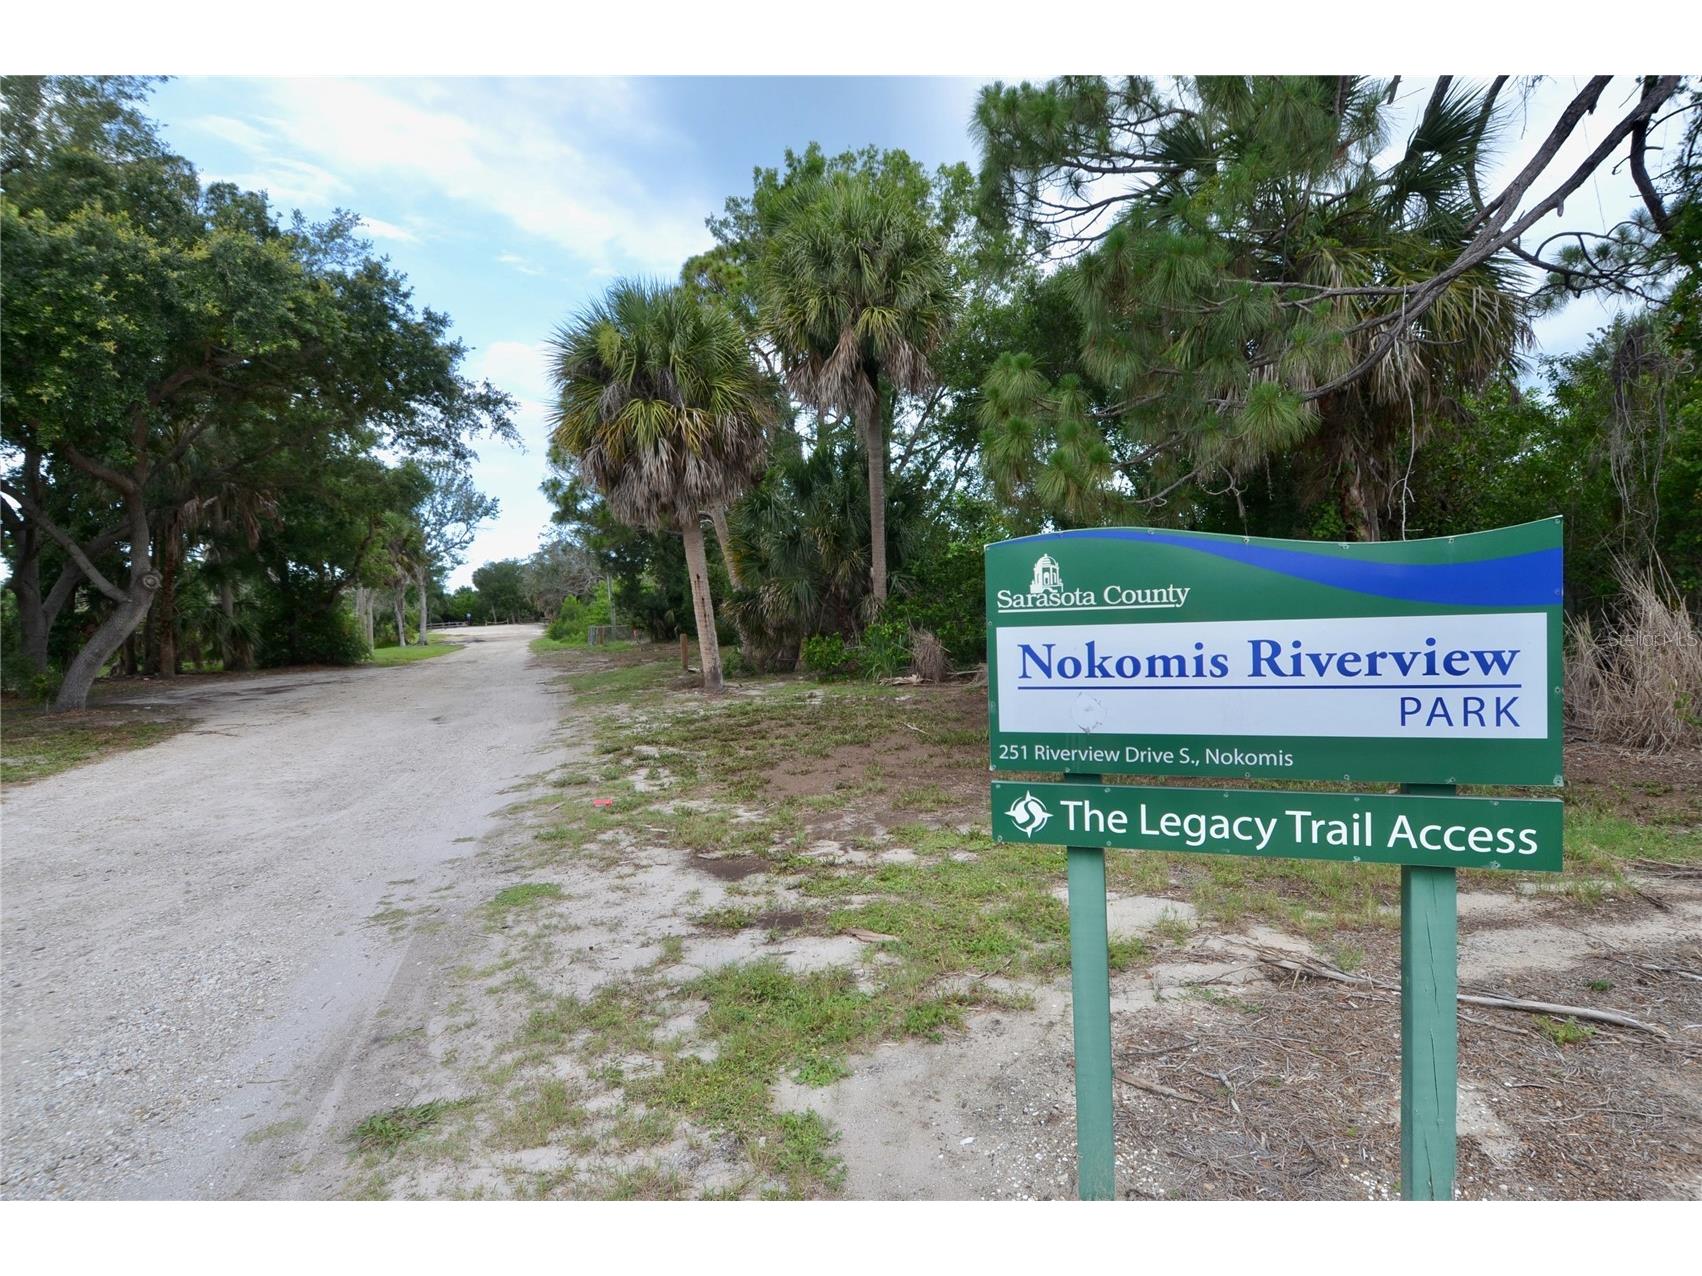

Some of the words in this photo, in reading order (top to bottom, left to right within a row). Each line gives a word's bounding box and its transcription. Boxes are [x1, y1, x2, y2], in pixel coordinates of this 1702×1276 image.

[997, 589, 1097, 609] Sarasota
[1102, 584, 1190, 608] County
[1018, 640, 1229, 680] Nokomis
[1248, 638, 1520, 678] Riverview
[1400, 696, 1520, 728] PARK
[999, 745, 1028, 760] 251
[1035, 745, 1120, 763] Riverview
[1125, 747, 1174, 764] Drive
[1180, 748, 1200, 766] S.,
[1205, 748, 1293, 766] Nokomis
[1060, 800, 1128, 833] The
[1141, 804, 1277, 850] Legacy
[1285, 810, 1373, 847] Trail
[1388, 815, 1538, 855] Access
